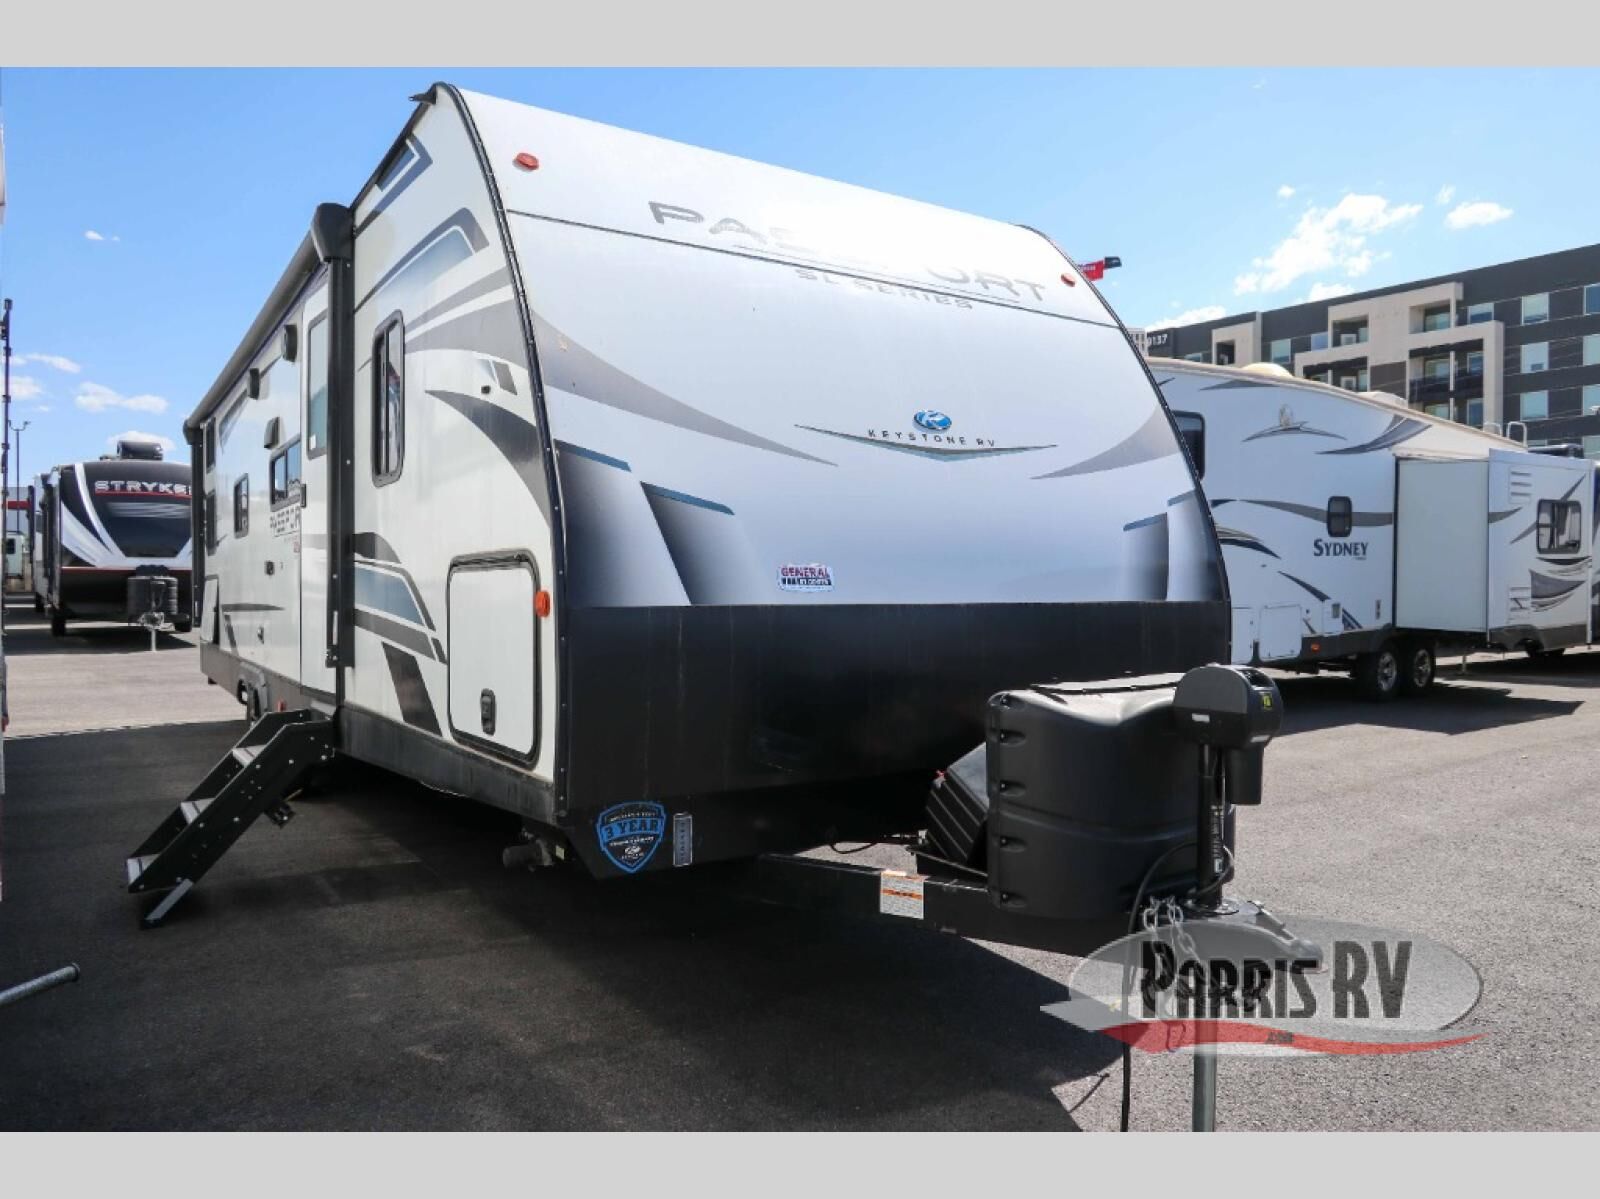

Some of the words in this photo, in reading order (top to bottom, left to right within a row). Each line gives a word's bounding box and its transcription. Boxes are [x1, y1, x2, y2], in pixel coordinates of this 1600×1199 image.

[852, 279, 973, 310] SERIES
[868, 429, 967, 446] KEYSTONE
[976, 437, 996, 447] RV
[1313, 538, 1369, 557] SYDNEY
[780, 567, 831, 579] GENERAL
